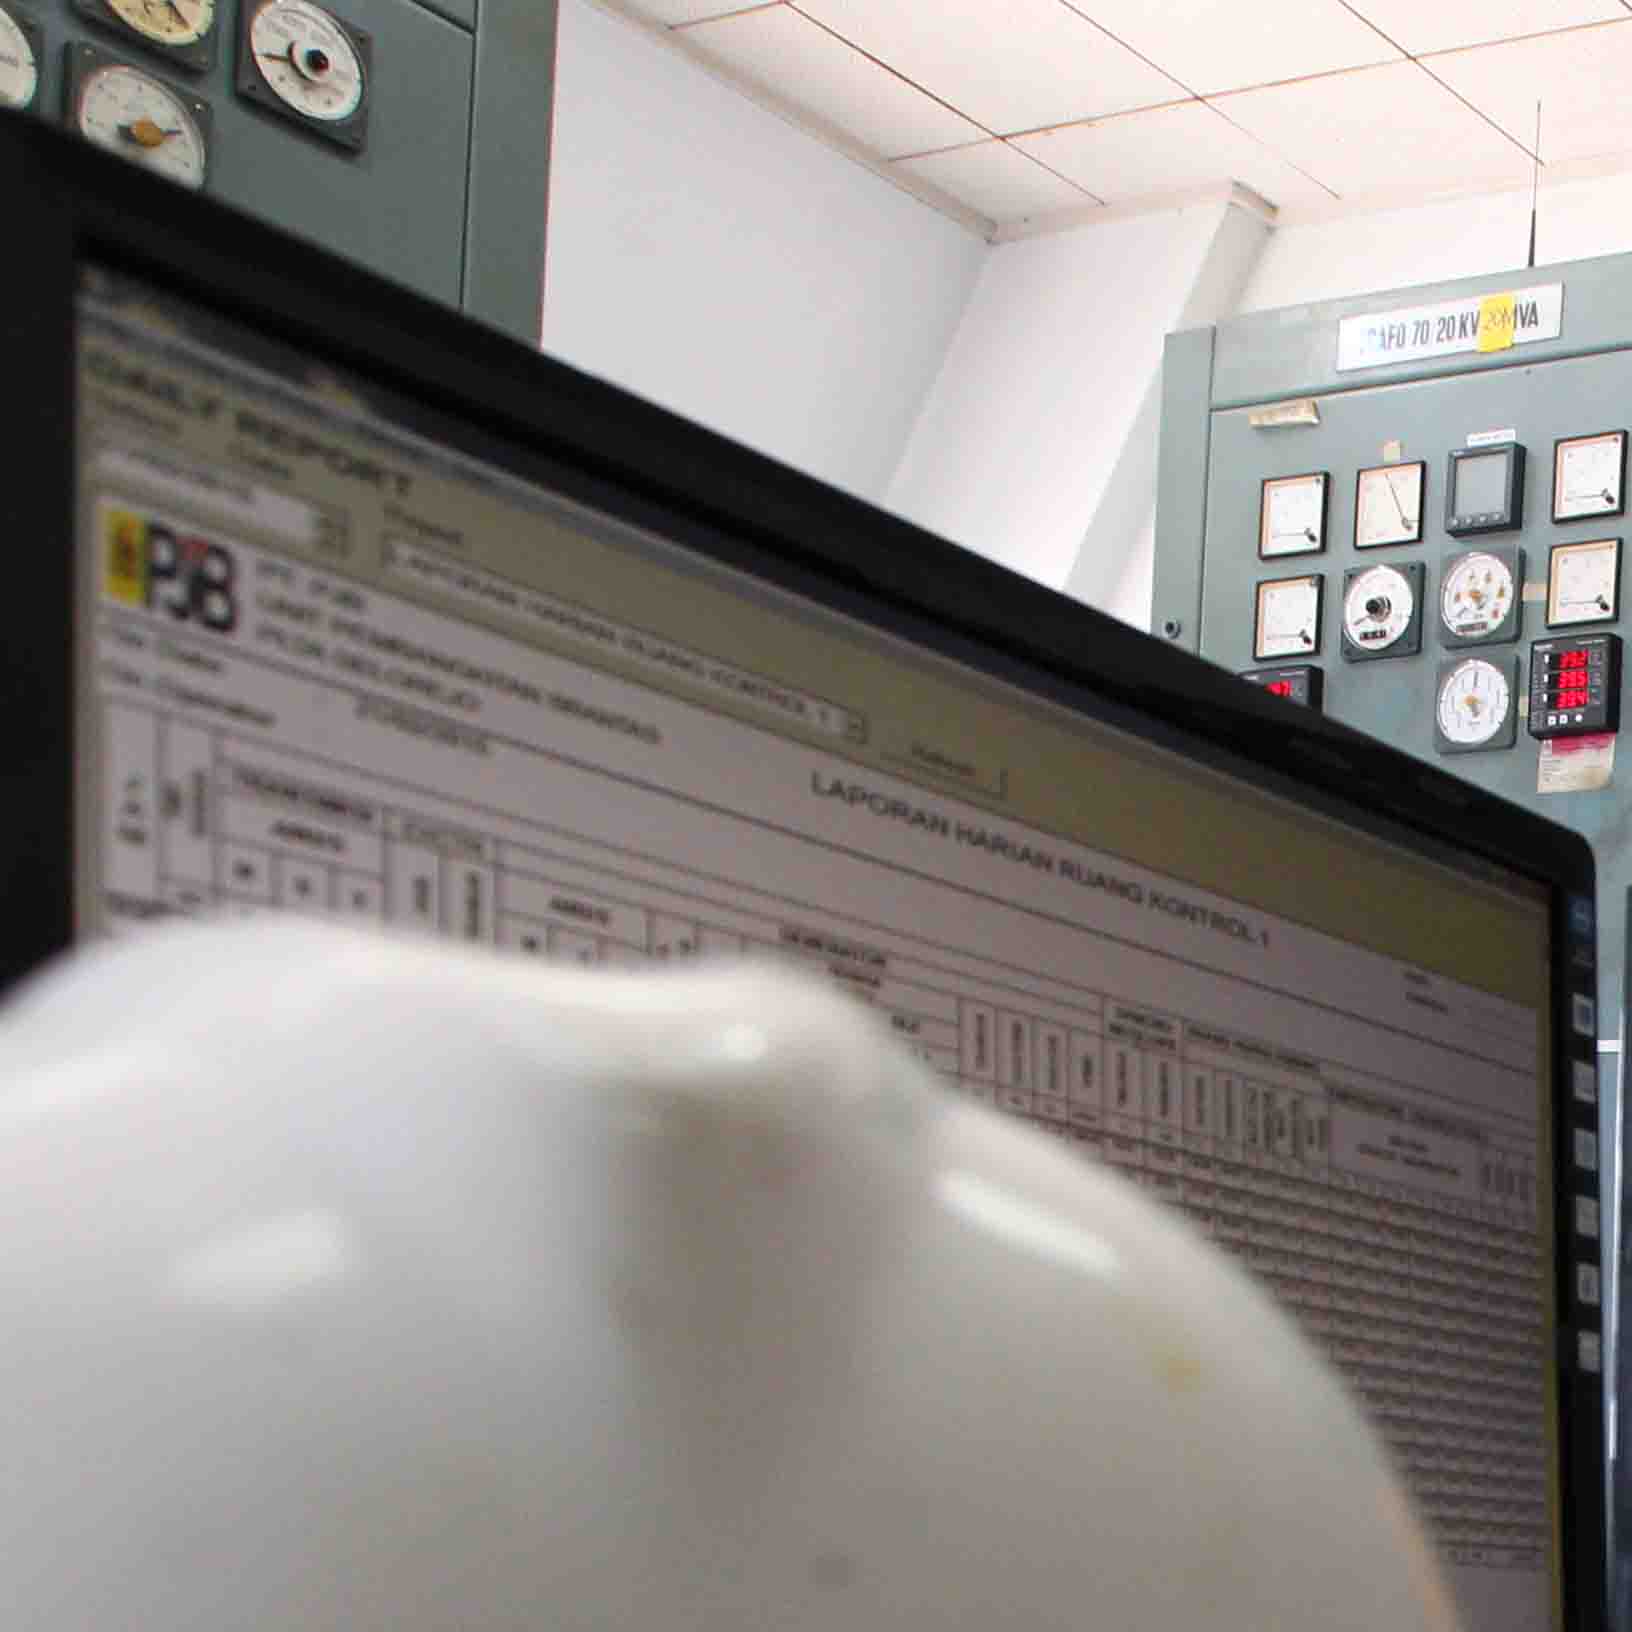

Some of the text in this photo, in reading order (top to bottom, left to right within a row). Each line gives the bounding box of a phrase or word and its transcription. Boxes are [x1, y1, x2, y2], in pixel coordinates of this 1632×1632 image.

[147, 521, 239, 634] PJB
[810, 771, 950, 839] LAPORAN
[955, 820, 1053, 874] HARIAN
[1058, 859, 1144, 906] RUANG
[1148, 890, 1254, 944] KONTROL
